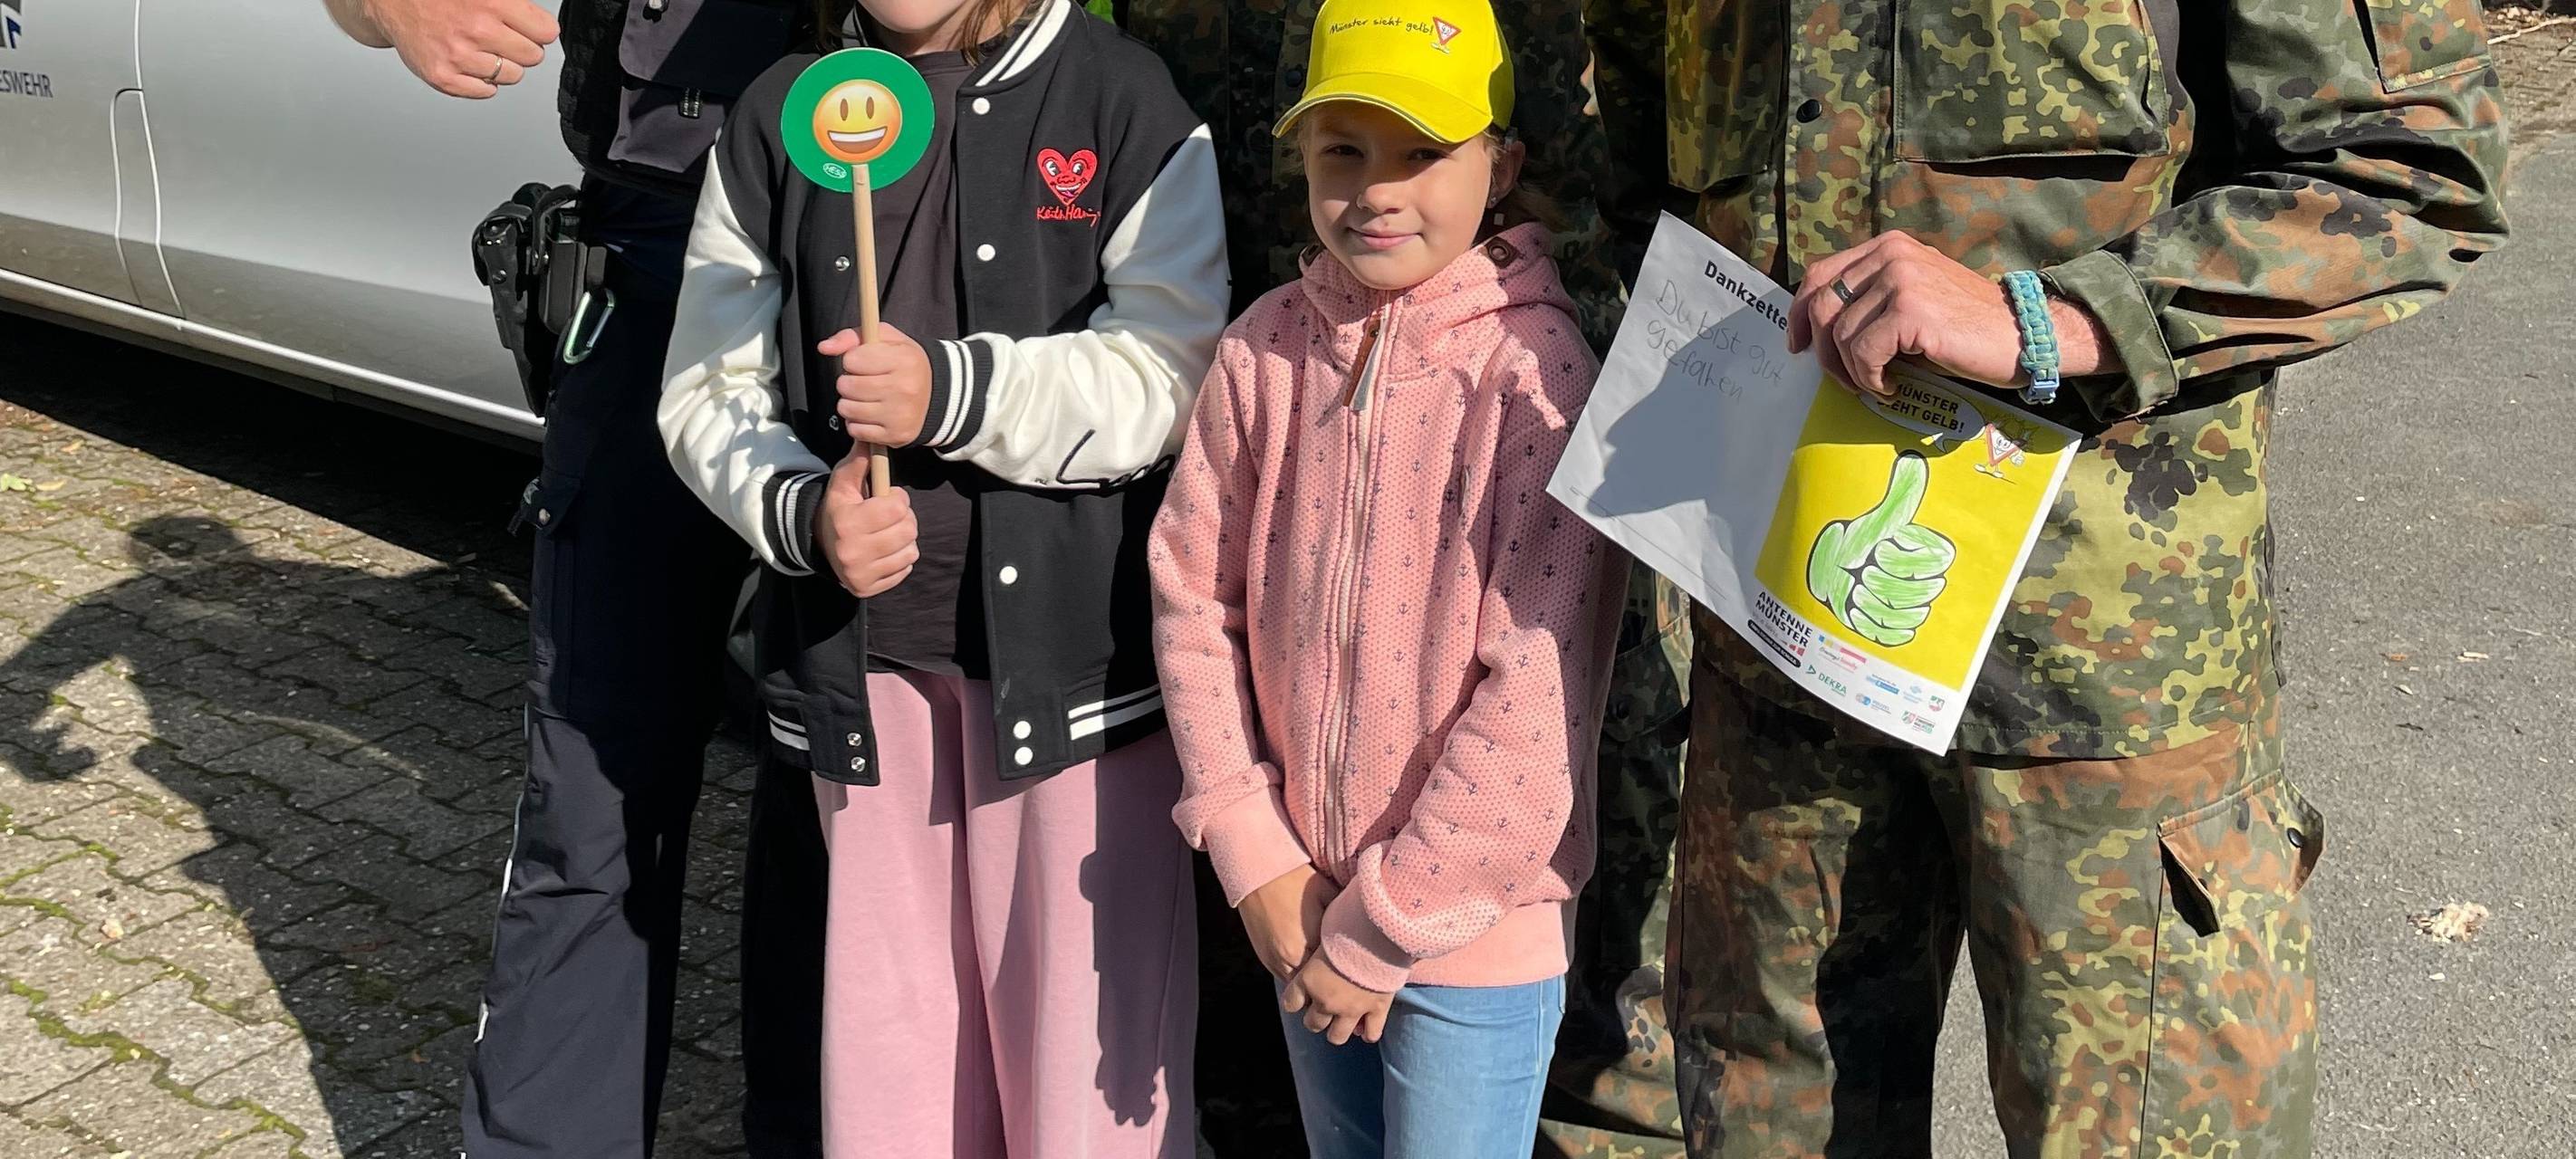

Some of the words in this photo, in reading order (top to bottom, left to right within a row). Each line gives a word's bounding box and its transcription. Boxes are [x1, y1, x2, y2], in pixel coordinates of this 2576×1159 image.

[1373, 17, 1401, 26] sieht
[1405, 22, 1434, 35] gelb!
[1656, 279, 1692, 324] Du
[1704, 260, 1790, 333] Dankzette
[1877, 399, 1920, 417] EHT
[1921, 409, 1966, 434] GELB!
[1755, 599, 1809, 648] MÜNSTER
[1758, 591, 1813, 639] ANTENNE
[1818, 673, 1847, 694] DEKRA
